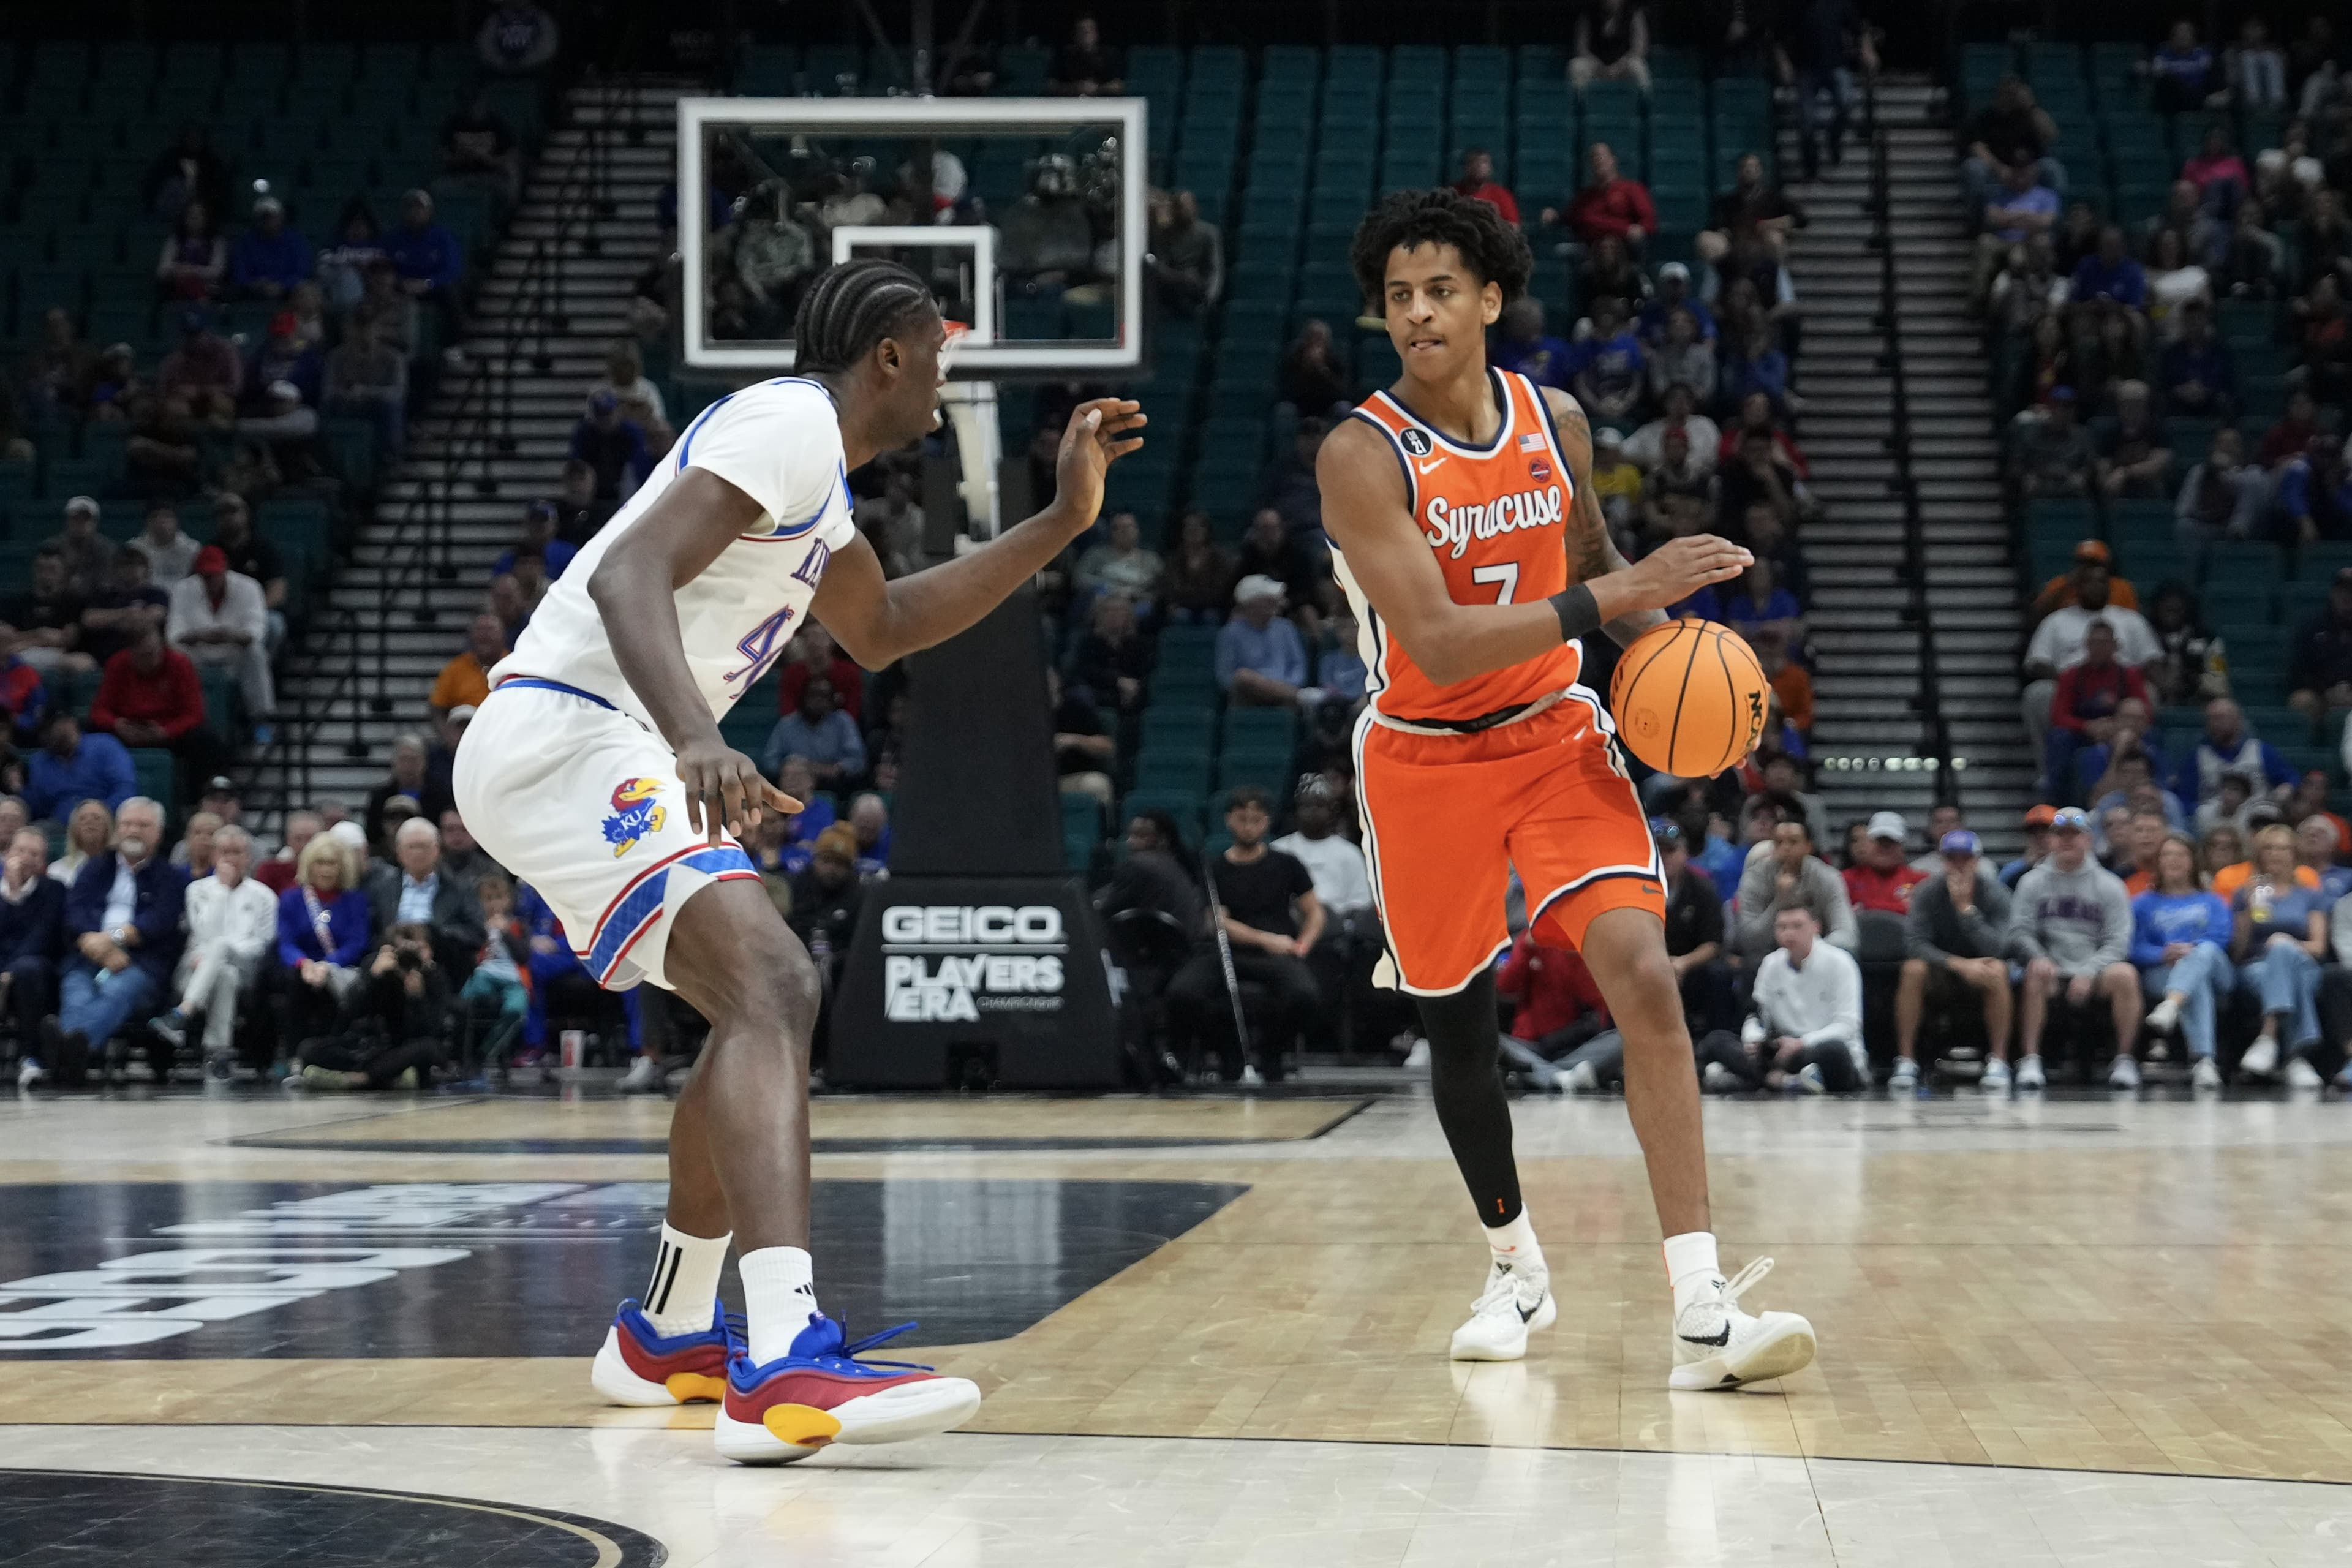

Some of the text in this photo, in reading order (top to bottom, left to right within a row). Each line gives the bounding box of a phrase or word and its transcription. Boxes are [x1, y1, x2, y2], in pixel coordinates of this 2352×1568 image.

[1411, 440, 1427, 454] 21
[1426, 484, 1562, 559] Syracuse
[1472, 562, 1520, 605] 7
[619, 810, 643, 831] KU
[882, 905, 1063, 944] GEICO
[885, 954, 1065, 993] PLAYERS
[886, 986, 980, 1022] ERA
